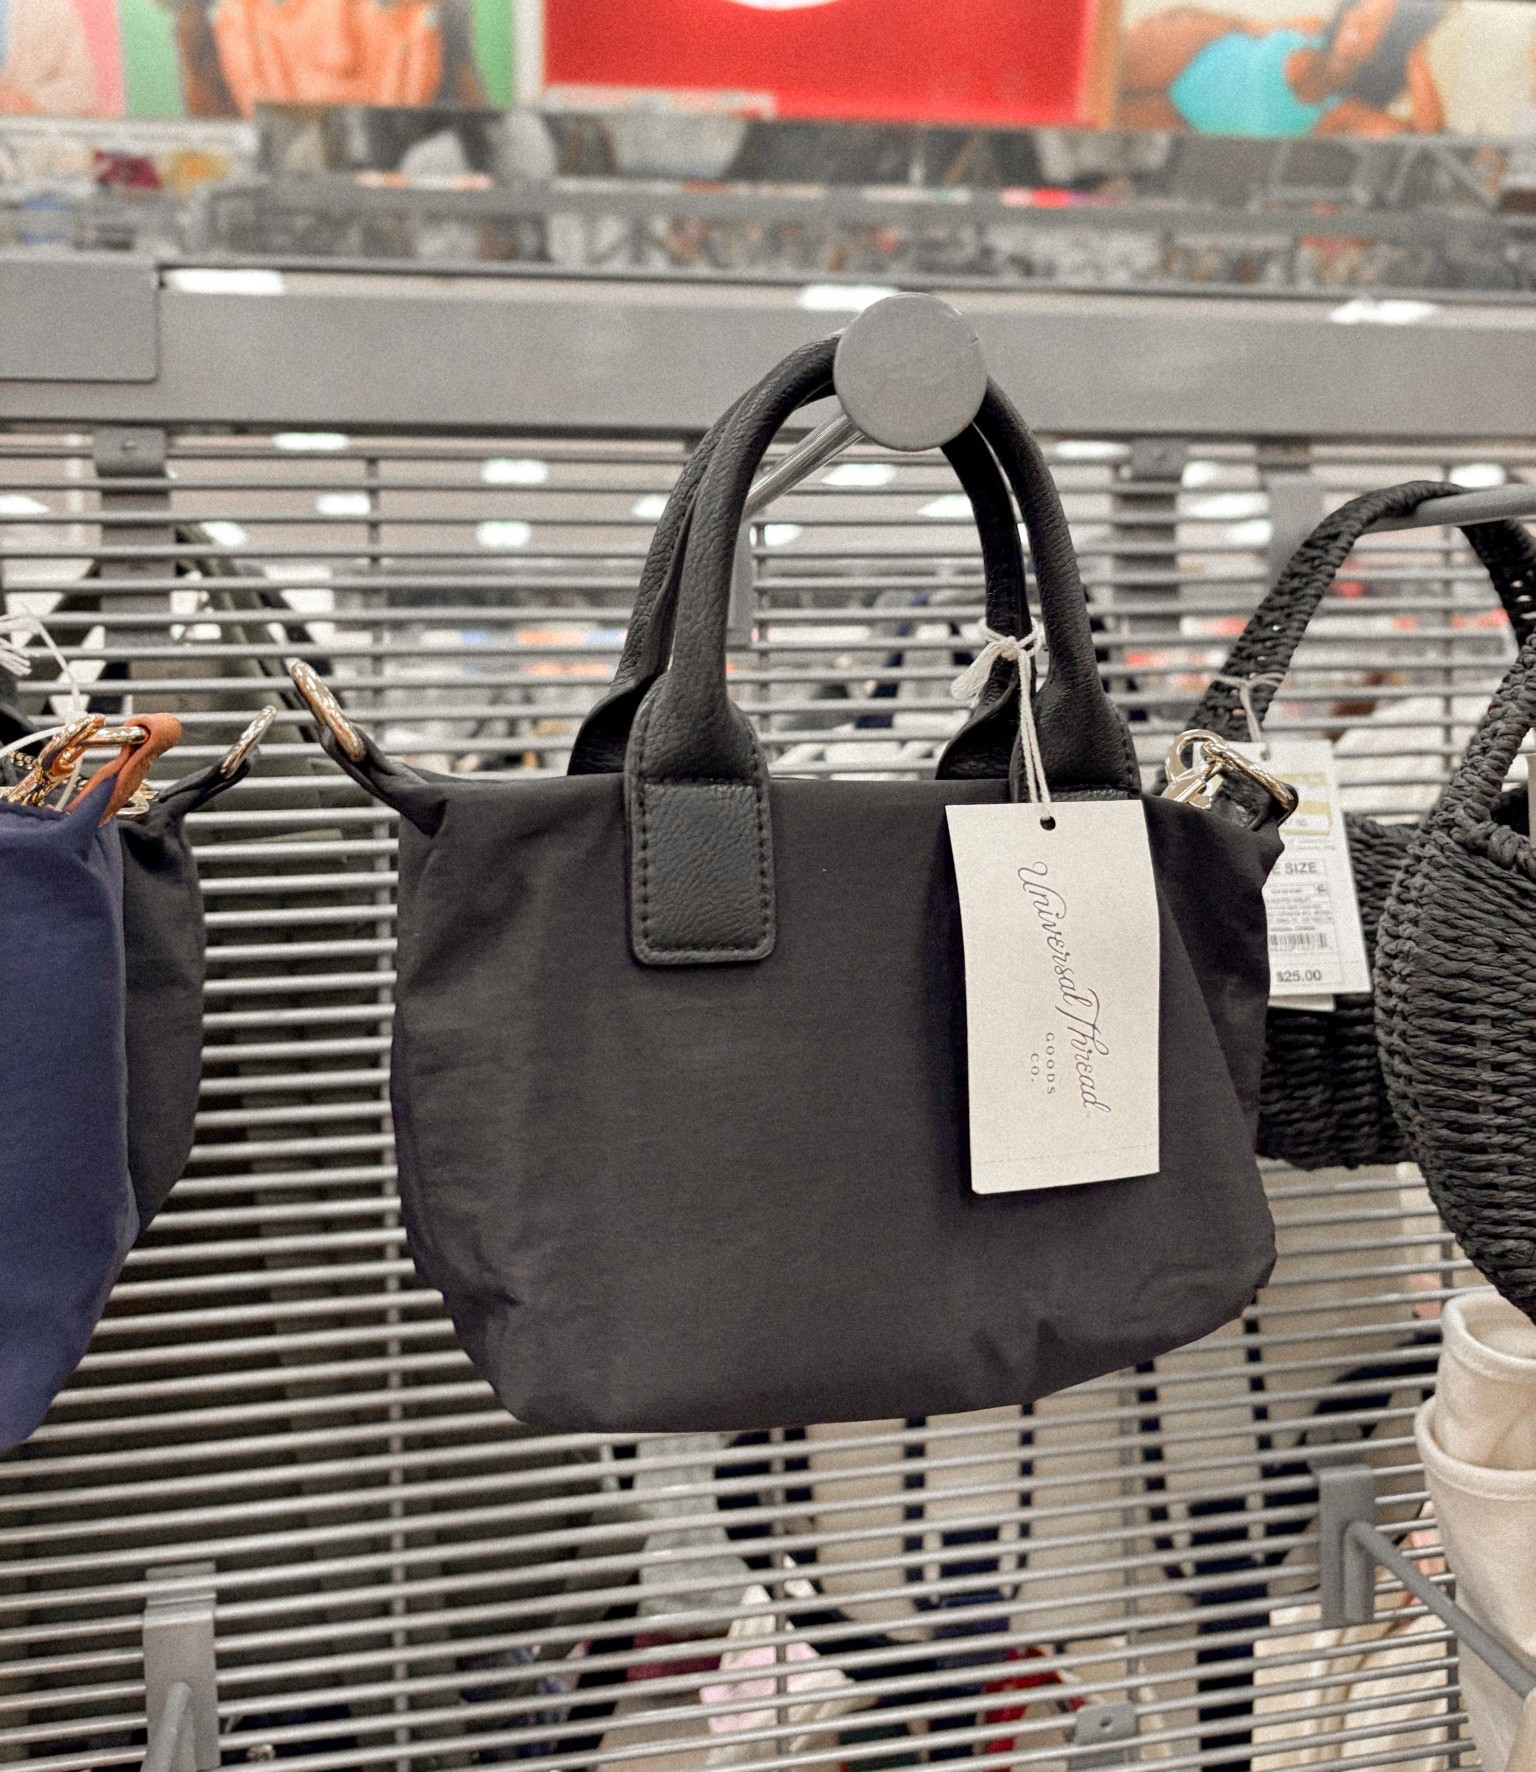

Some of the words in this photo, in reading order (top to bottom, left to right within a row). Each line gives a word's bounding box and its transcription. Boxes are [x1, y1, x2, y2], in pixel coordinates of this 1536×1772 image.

[1284, 861, 1318, 875] SIZE
[1017, 861, 1093, 1007] Universal
[1276, 969, 1322, 983] $25.00
[1030, 1053, 1040, 1083] CO.
[1045, 1032, 1056, 1095] GOODS
[1054, 988, 1112, 1113] Thread
